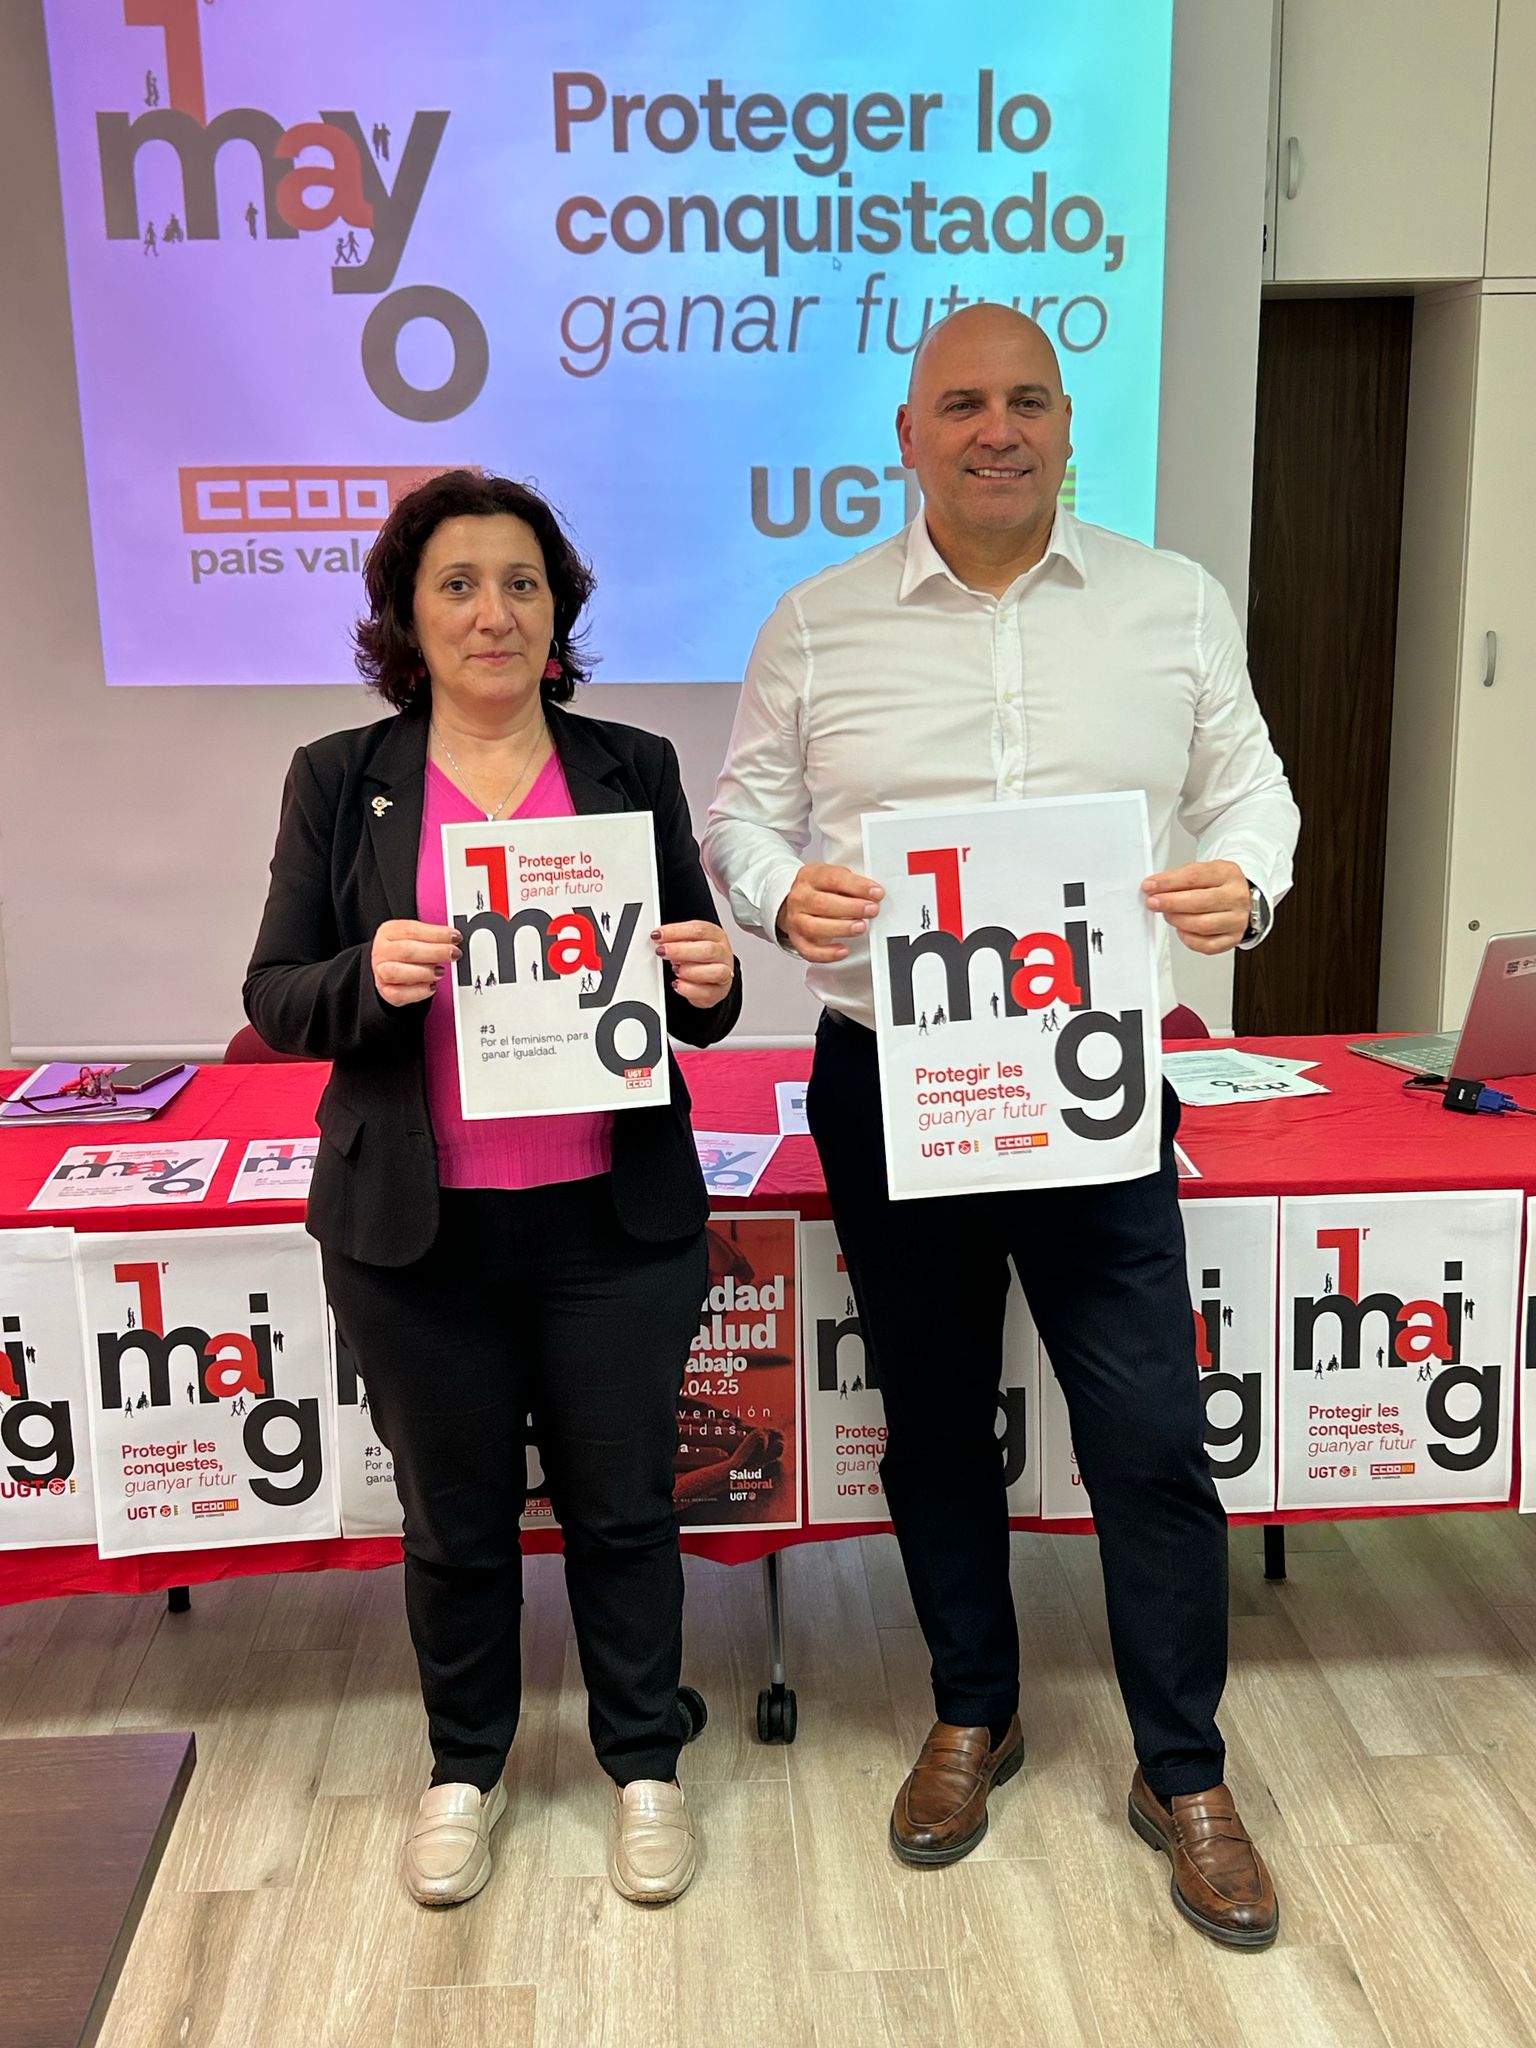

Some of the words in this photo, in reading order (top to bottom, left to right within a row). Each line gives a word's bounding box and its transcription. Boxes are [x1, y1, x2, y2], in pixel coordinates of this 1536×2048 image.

[123, 0, 214, 128] 1
[553, 72, 942, 176] Proteger
[977, 69, 1050, 152] lo
[556, 172, 1124, 277] conquistado,
[560, 293, 820, 377] ganar
[196, 480, 389, 520] CCOO
[190, 539, 285, 584] país
[295, 538, 367, 573] val
[519, 855, 576, 869] Proteger
[580, 851, 592, 864] lo
[520, 866, 604, 885] conquistado,
[521, 885, 559, 902] ganar
[565, 882, 603, 895] futuro
[480, 1024, 496, 1034] #3
[481, 1037, 497, 1047] Por
[500, 1036, 509, 1046] el
[512, 1034, 564, 1046] feminismo,
[567, 1032, 589, 1043] para
[481, 1051, 510, 1062] ganar
[513, 1046, 557, 1060] igualdad.
[627, 1070, 642, 1078] UGT
[915, 1063, 990, 1085] Protegir
[997, 1061, 1023, 1078] les
[627, 1079, 651, 1088] CCOO
[917, 1084, 1030, 1106] conquestes,
[918, 1107, 995, 1131] guanyar
[1003, 1101, 1047, 1119] futur
[921, 1141, 955, 1158] UGT
[997, 1136, 1032, 1149] CCOO
[690, 1314, 776, 1350] alud
[685, 1352, 747, 1377] abajo
[679, 1379, 739, 1396] .04.25
[679, 1406, 771, 1418] vención
[1309, 1404, 1372, 1422] Protegir
[1378, 1403, 1399, 1417] les
[835, 1425, 888, 1441] Proteg
[1308, 1421, 1404, 1439] conquestes,
[122, 1441, 187, 1459] Protegir
[194, 1439, 216, 1453] les
[365, 1446, 381, 1456] #3
[836, 1443, 885, 1458] conqu
[1308, 1441, 1374, 1458] guanyar
[1379, 1436, 1416, 1450] futur
[124, 1458, 223, 1477] conquestes,
[366, 1460, 382, 1470] Por
[386, 1461, 393, 1469] e
[1308, 1467, 1337, 1479] UGT
[1372, 1465, 1401, 1474] CCOO
[366, 1475, 393, 1486] gana
[729, 1468, 762, 1480] Salud
[1, 1479, 44, 1498] UGT
[125, 1477, 192, 1497] guanyar
[199, 1472, 237, 1487] futur
[729, 1479, 773, 1490] Laboral
[837, 1484, 865, 1496] UGT
[729, 1492, 748, 1501] UGT
[127, 1506, 157, 1520] UGT
[194, 1502, 224, 1512] CCOO
